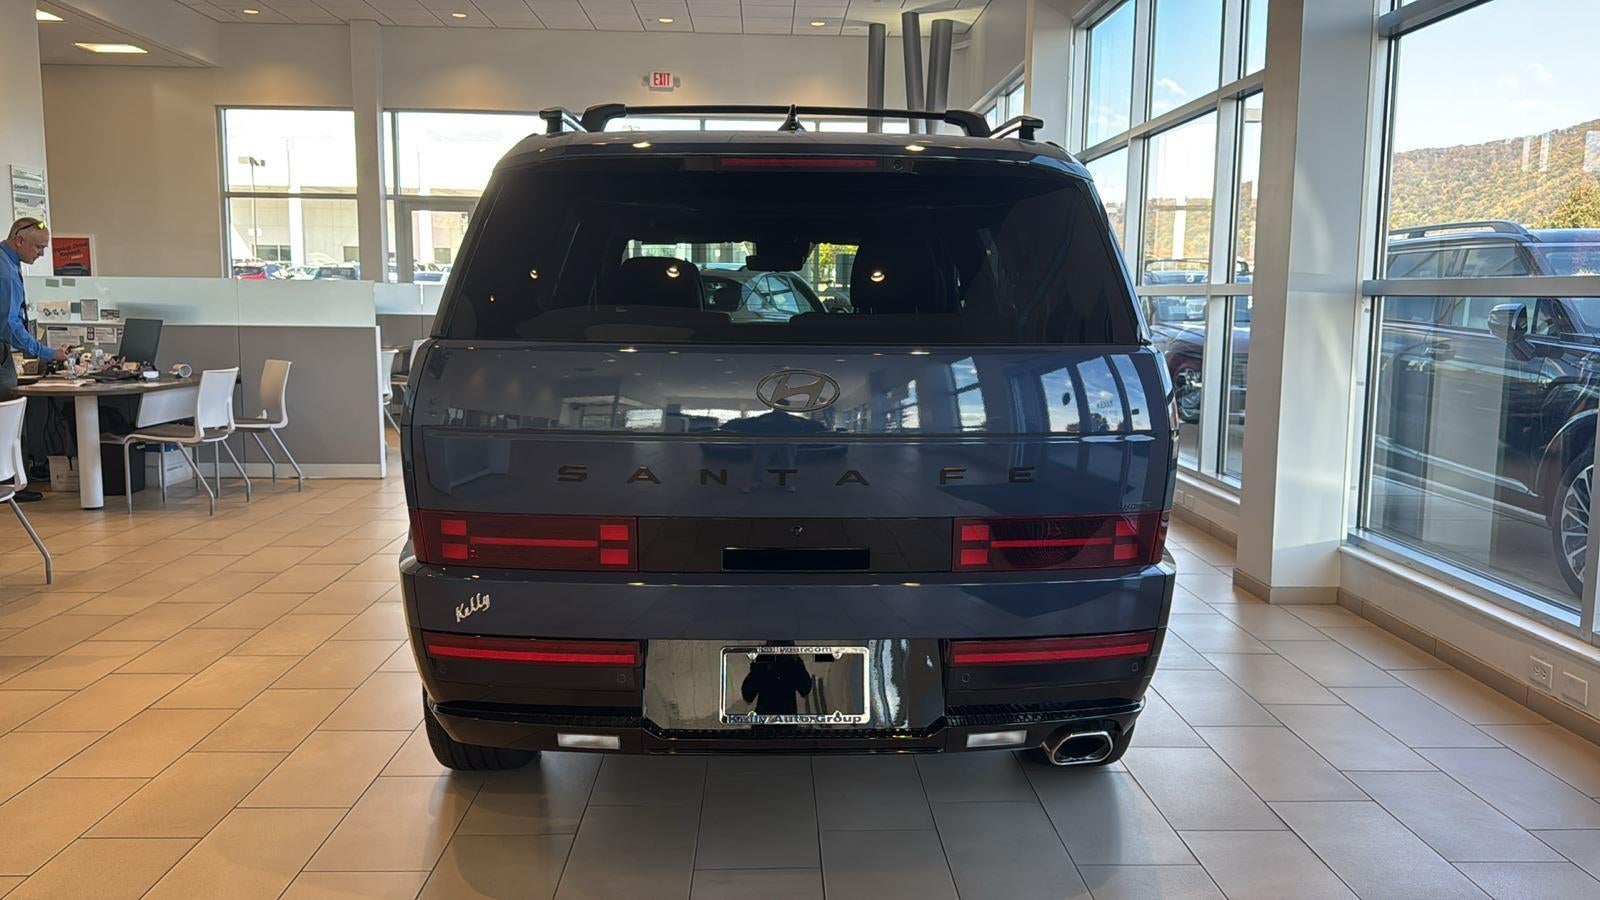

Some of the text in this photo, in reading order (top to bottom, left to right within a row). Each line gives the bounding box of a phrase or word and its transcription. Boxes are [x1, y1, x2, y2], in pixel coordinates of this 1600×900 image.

[653, 72, 670, 86] EXIT
[557, 465, 1035, 486] SANTA FE
[455, 592, 491, 623] Kelly
[728, 714, 862, 724] Kelly Auto Group
